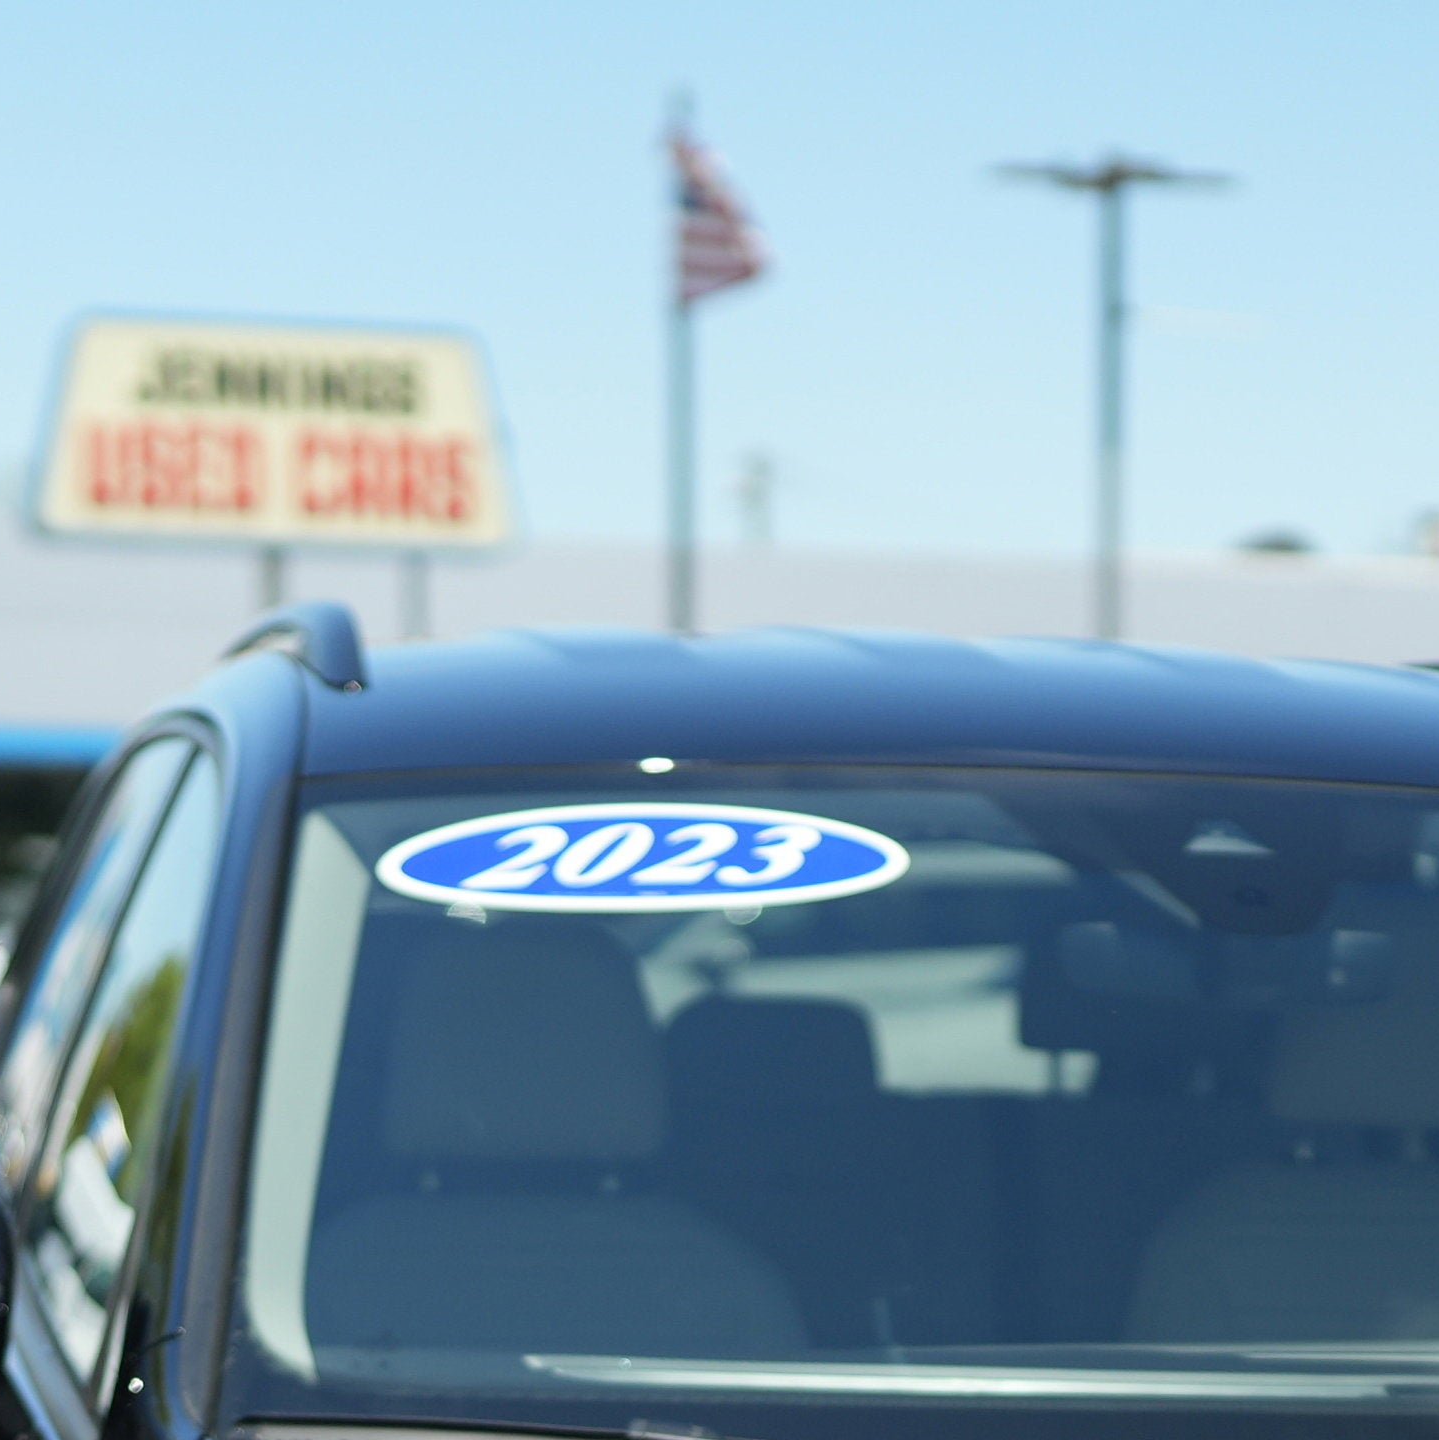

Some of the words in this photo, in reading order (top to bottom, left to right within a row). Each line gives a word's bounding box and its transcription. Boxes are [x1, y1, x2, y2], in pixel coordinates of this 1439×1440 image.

[137, 345, 419, 413] JENNINGS
[89, 424, 258, 510] USED
[294, 428, 473, 521] CARS
[459, 822, 822, 890] 2023
